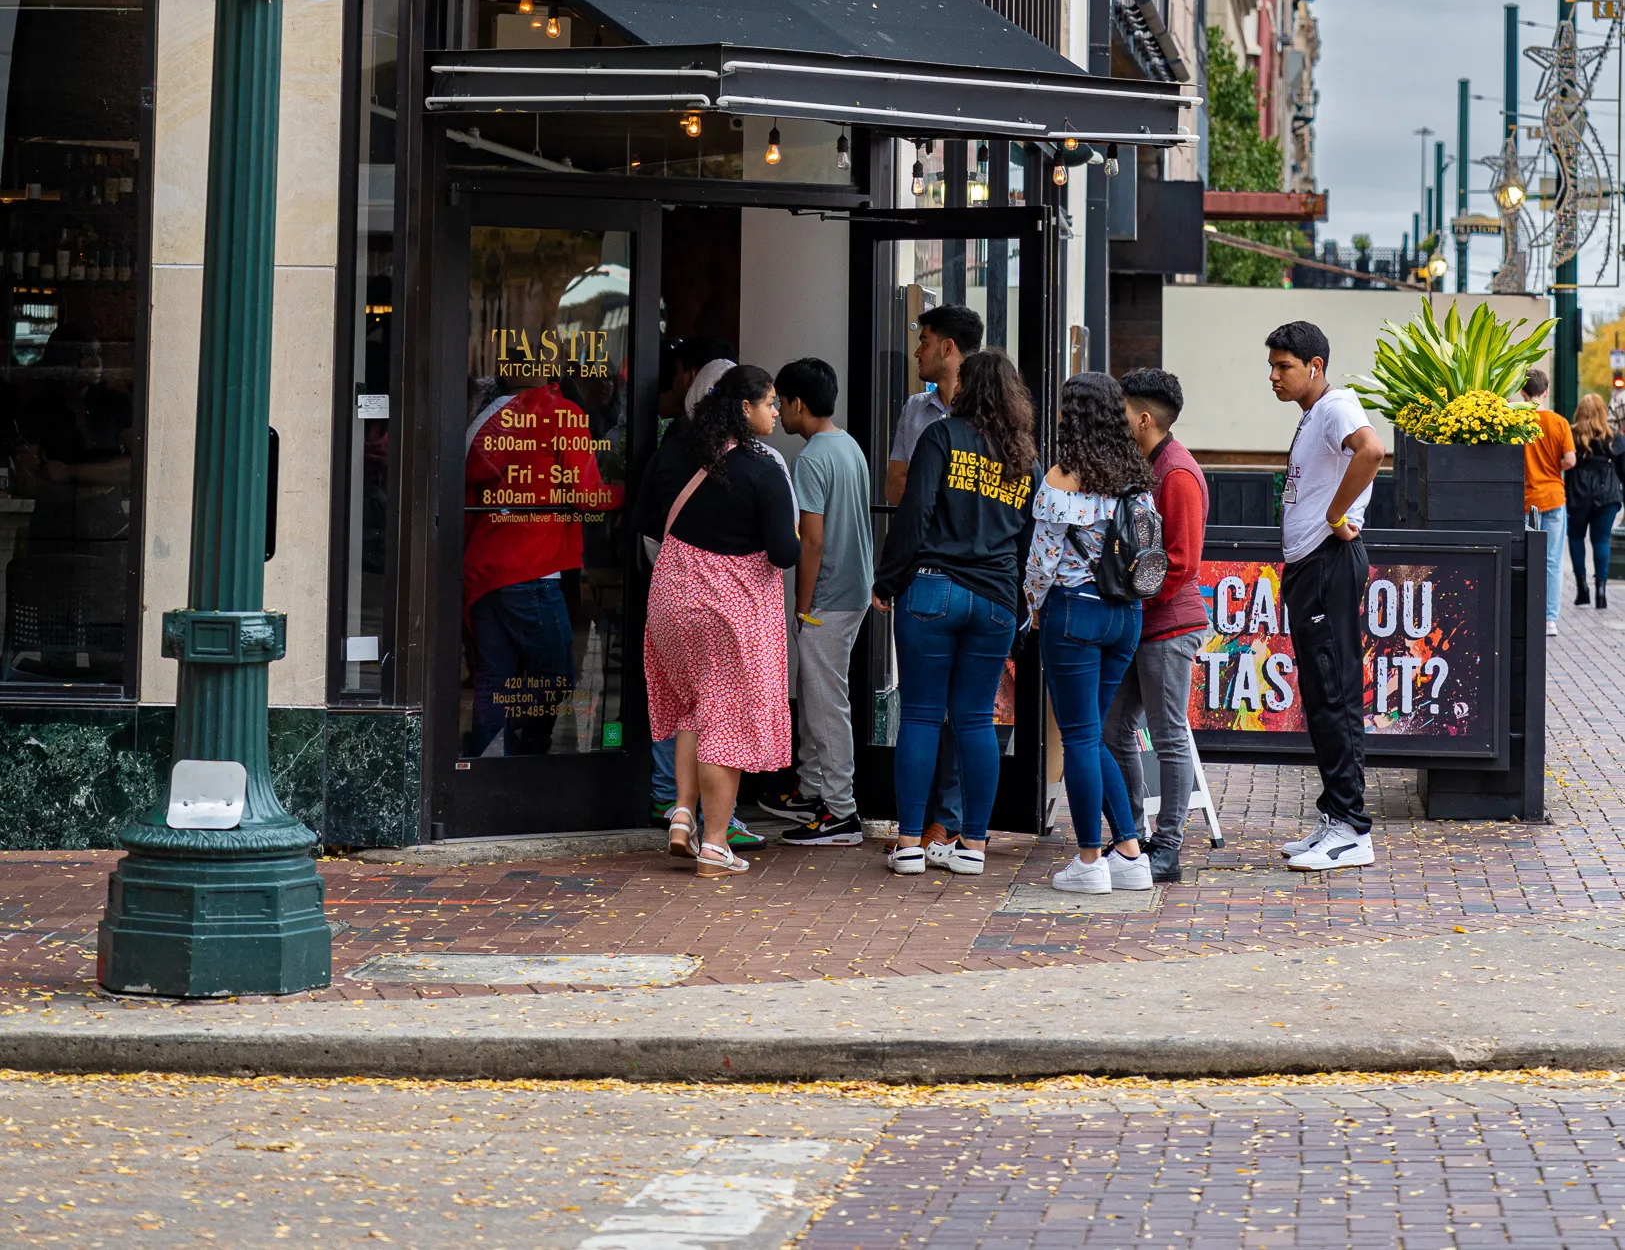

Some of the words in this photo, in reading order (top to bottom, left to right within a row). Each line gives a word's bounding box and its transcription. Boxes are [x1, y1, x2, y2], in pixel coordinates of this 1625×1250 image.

[491, 328, 608, 362] TASTE
[500, 363, 561, 377] KITCHEN
[580, 364, 608, 378] BAR
[500, 409, 537, 428] Sun
[555, 409, 589, 428] Thu
[484, 436, 537, 451] 8:00am
[551, 436, 611, 454] 10:00pm
[507, 465, 532, 484] Fri
[549, 465, 580, 484] Sat
[980, 469, 1018, 493] YOURE
[1016, 483, 1031, 498] IT
[483, 489, 536, 504] 8:00am
[549, 489, 612, 507] Midnight
[1014, 495, 1026, 510] IT
[530, 513, 551, 523] Never
[553, 512, 571, 523] Taste
[573, 513, 582, 523] So
[1216, 576, 1290, 635] CA
[1368, 579, 1433, 638] OU
[504, 677, 522, 689] 420
[527, 676, 551, 688] Main
[556, 676, 572, 687] St.
[1200, 652, 1294, 713] TAS
[1377, 656, 1449, 716] IT?
[493, 692, 537, 704] Houston,
[544, 690, 556, 702] TX
